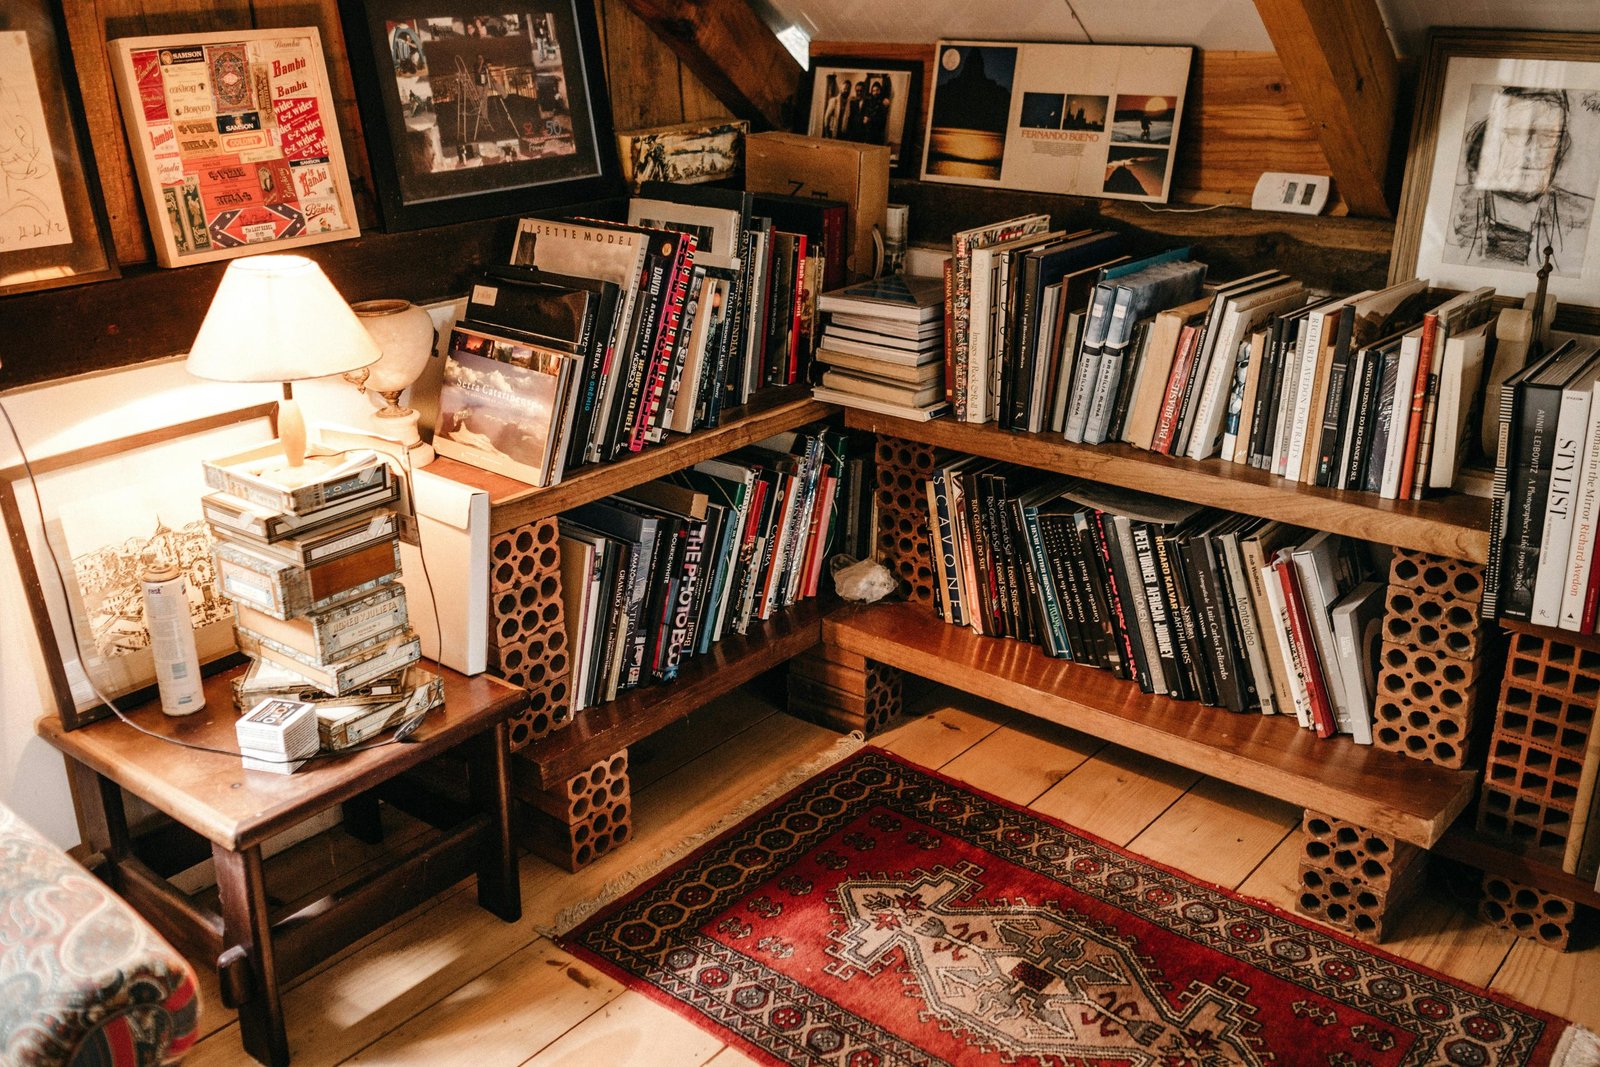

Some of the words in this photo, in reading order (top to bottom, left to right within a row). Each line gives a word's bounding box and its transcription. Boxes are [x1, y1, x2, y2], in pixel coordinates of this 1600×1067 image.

[173, 51, 202, 59] SAMSON
[272, 57, 306, 78] Bambú
[276, 81, 308, 97] Bambú
[280, 111, 292, 122] e-z
[293, 101, 314, 115] wider
[226, 124, 254, 132] SAMSON
[287, 129, 300, 140] e-z
[300, 120, 320, 133] wider
[1022, 130, 1068, 140] FERNANDO
[1069, 133, 1099, 142] BUENO
[284, 144, 296, 154] e-z
[296, 133, 317, 147] wider
[302, 146, 314, 156] e-z
[522, 224, 576, 239] LISETTE
[584, 231, 632, 246] MODEL
[648, 266, 664, 295] DAVID
[666, 239, 688, 306] HOTEL
[621, 295, 635, 332] MODEL
[657, 235, 698, 381] LACHAPELLE
[725, 291, 734, 317] ITALY:
[794, 296, 802, 316] spirit
[721, 317, 730, 343] Seasons
[728, 309, 741, 357] MUNDIAL
[1305, 317, 1318, 362] RICHARD
[592, 341, 602, 369] ARENA
[970, 332, 980, 356] Images
[626, 351, 640, 388] MIGRATIONS
[717, 353, 725, 371] Light
[971, 366, 979, 382] Rock
[1079, 357, 1089, 392] BRASÍLIA
[1364, 360, 1374, 387] ANTIGAS
[457, 378, 480, 391] Serra
[631, 358, 644, 395] HEAVEN
[634, 310, 672, 441] LACHAPELLE
[1100, 358, 1112, 393] BRASÍLIA
[1299, 366, 1311, 403] AVEDON
[584, 380, 596, 411] GRÊMIO
[627, 396, 636, 409] TO
[970, 394, 979, 408] Roll
[1184, 384, 1192, 398] SANTA
[1360, 387, 1369, 415] FAZENDAS
[1074, 394, 1082, 416] PLENA
[1095, 395, 1103, 417] PLENA
[1158, 382, 1180, 439] PAU-BRASIL
[622, 410, 633, 433] HELL
[1291, 407, 1305, 458] PORTRAITS
[1534, 409, 1545, 434] ANNIE
[802, 440, 813, 466] BIRDS
[1353, 436, 1362, 461] GRANDE
[1528, 435, 1542, 474] LEIBOVITZ
[1589, 459, 1599, 470] in
[1548, 438, 1576, 520] STYLIST
[1586, 471, 1597, 487] the
[791, 480, 805, 517] BRITAIN
[984, 495, 994, 507] Rio
[997, 498, 1007, 510] Rio
[1518, 485, 1535, 533] Photographer's
[1581, 488, 1595, 520] Mirror
[973, 513, 982, 542] GRANDE
[987, 507, 996, 527] Grande
[999, 510, 1009, 530] Grande
[684, 521, 707, 563] THE
[763, 524, 778, 567] CAMERA
[931, 474, 963, 608] SCAVONE
[990, 528, 998, 539] do
[991, 539, 1000, 552] Sul
[1002, 531, 1010, 543] do
[1121, 532, 1132, 555] ANNIE
[1132, 528, 1149, 551] PETE
[1575, 523, 1589, 561] Richard
[663, 532, 678, 584] BOURKE-WHITE
[781, 550, 789, 572] Green
[976, 544, 984, 556] DO
[1003, 543, 1012, 555] Sul
[1029, 524, 1039, 545] HENRI
[1034, 545, 1046, 573] CARTIER
[1041, 573, 1053, 600] BRESSON
[1248, 553, 1256, 565] Bob
[627, 552, 639, 589] AMAZÔNIA
[994, 561, 1004, 584] Leonid
[1006, 565, 1016, 587] Leonid
[1053, 558, 1064, 579] Brasil
[1063, 560, 1075, 582] Brasil
[1077, 559, 1089, 581] Brasil
[1126, 555, 1140, 592] LEIBOVITZ
[1137, 550, 1157, 584] TURNER
[1487, 565, 1495, 591] MAGAZINE
[1569, 562, 1583, 597] Avedon
[614, 569, 625, 607] GRAMADO
[1058, 579, 1066, 590] do
[1069, 583, 1078, 593] do
[1084, 582, 1092, 593] do
[1198, 574, 1209, 598] Fotografia
[1251, 565, 1262, 597] Wolfenson
[1061, 590, 1074, 620] Coração
[1072, 593, 1085, 623] Coração
[1087, 593, 1100, 622] Coração
[1134, 592, 1147, 622] WOMEN
[1144, 584, 1166, 622] AFRICAN
[1154, 535, 1170, 575] RICHARD
[1163, 575, 1178, 610] KALVAR
[1171, 610, 1190, 664] EARTHLINGS
[333, 618, 359, 633] ROMEO
[365, 602, 397, 622] JULIETA
[1205, 605, 1216, 622] Luiz
[1237, 596, 1255, 646] Montevideo
[683, 621, 695, 647] Brasil
[1141, 622, 1153, 648] SUSAN
[1153, 620, 1175, 660] JOURNEY
[1209, 622, 1221, 646] Carlos
[1147, 649, 1160, 679] SONTAG
[1214, 646, 1229, 680] Felizardo
